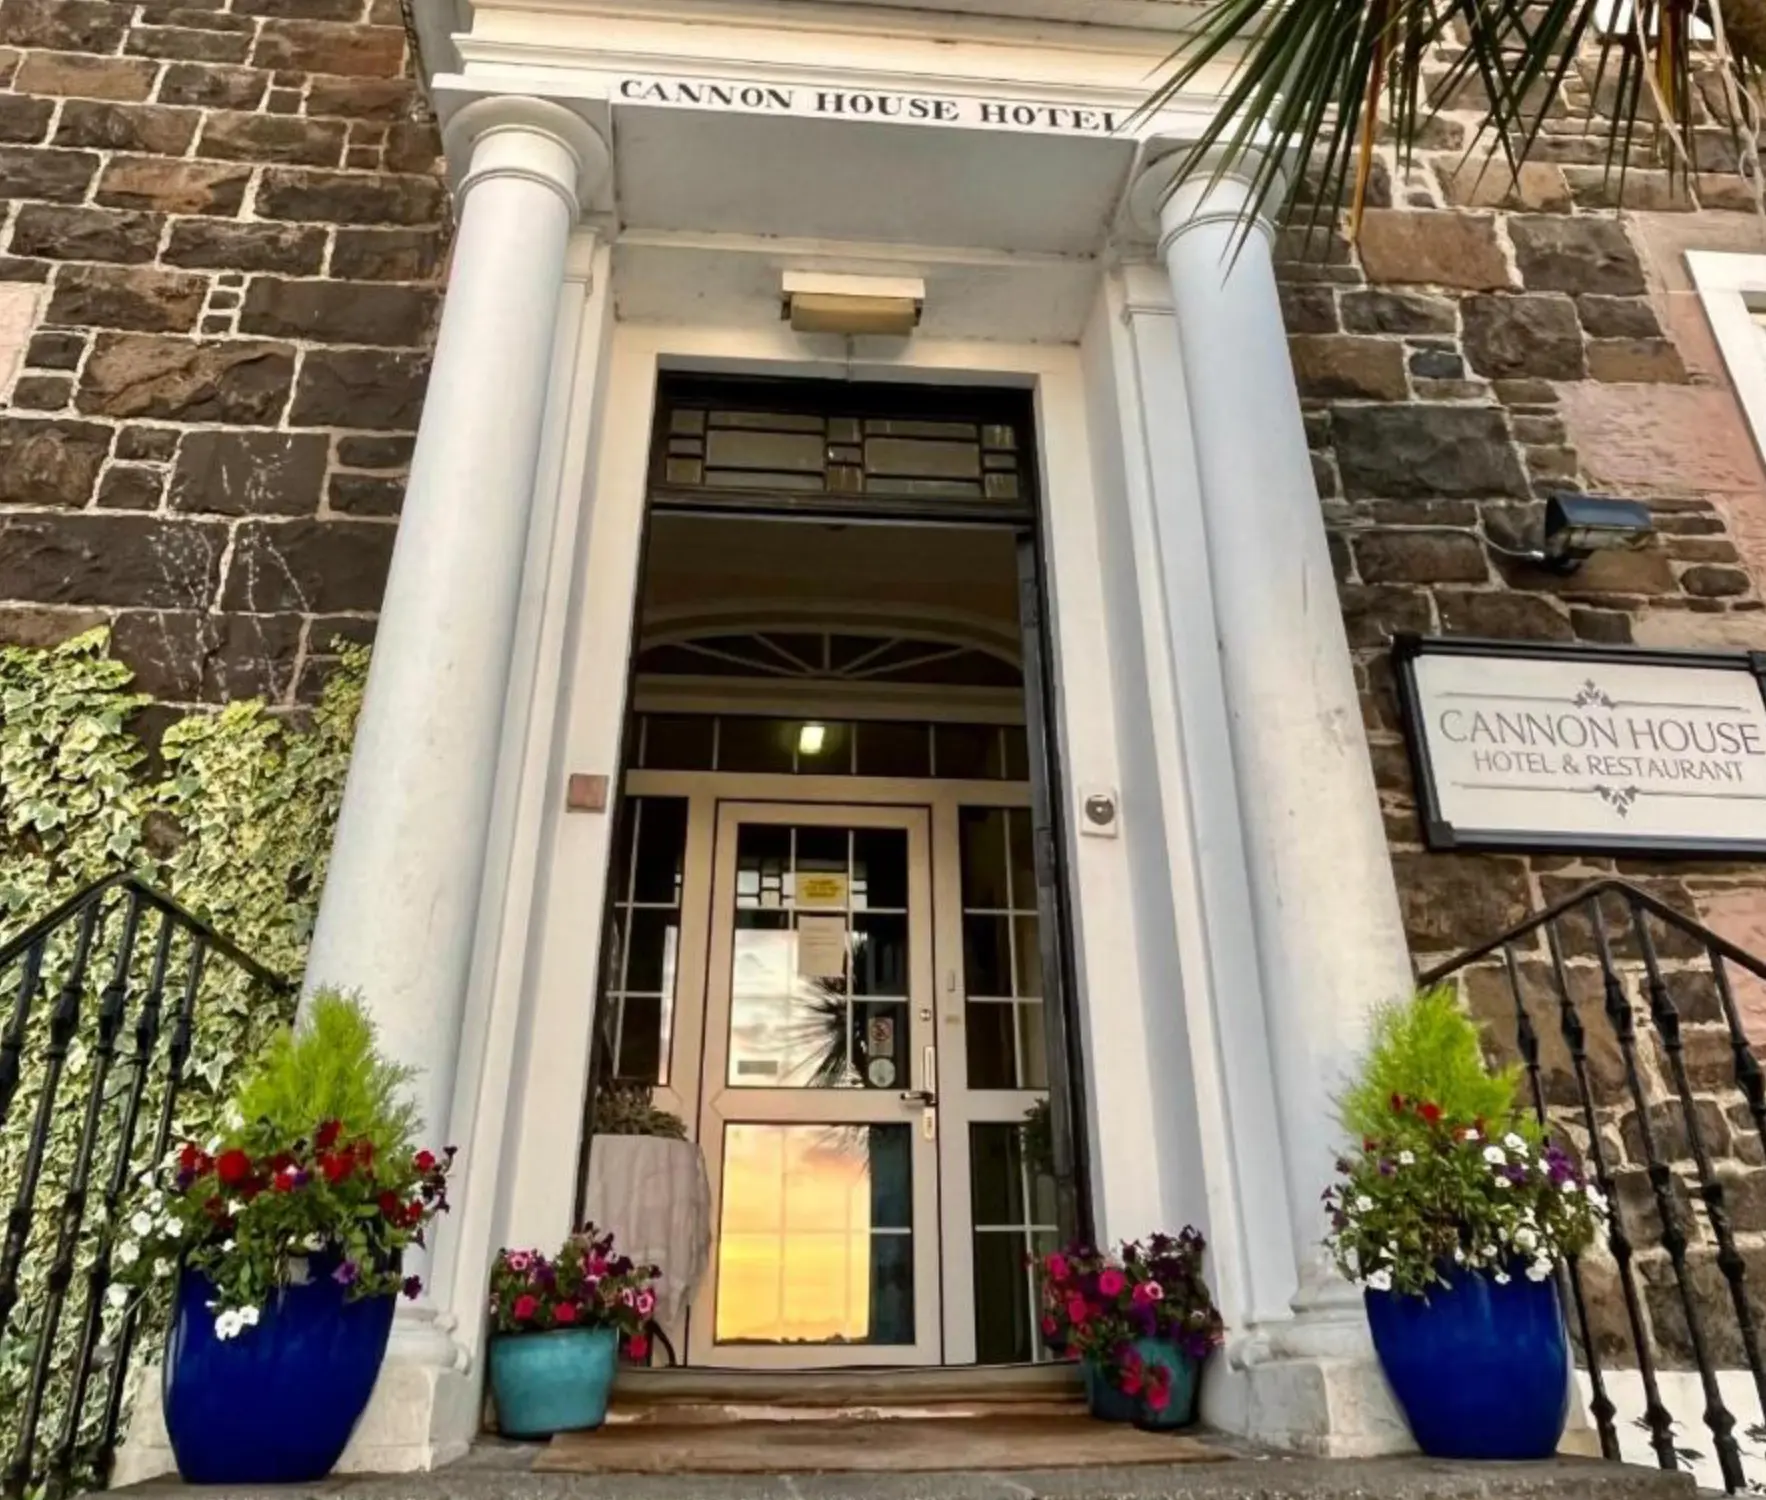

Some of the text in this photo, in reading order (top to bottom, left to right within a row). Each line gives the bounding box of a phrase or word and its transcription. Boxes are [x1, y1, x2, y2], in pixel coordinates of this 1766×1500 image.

[620, 80, 794, 109] CANNON
[817, 93, 959, 121] HOUSE
[1440, 709, 1766, 756] CANNON HOUSE
[1473, 750, 1743, 783] HOTEL & RESTAURANT
